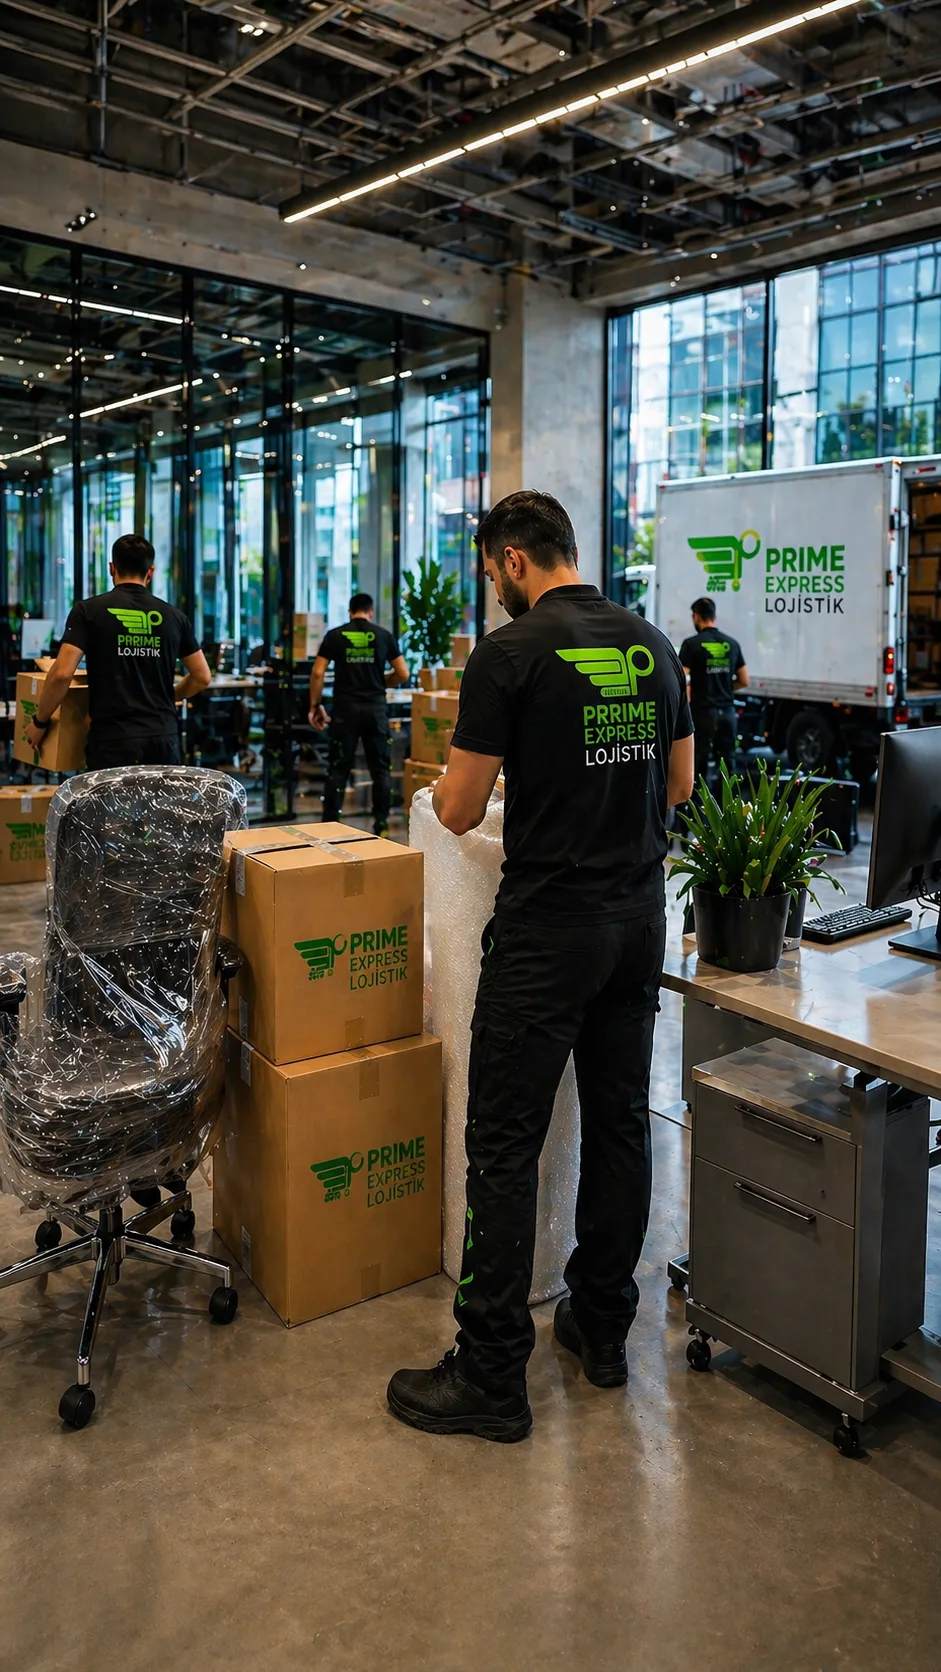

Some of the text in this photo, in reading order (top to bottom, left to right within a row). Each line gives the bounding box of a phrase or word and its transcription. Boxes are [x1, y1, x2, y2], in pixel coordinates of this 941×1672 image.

[766, 545, 845, 573] PRIME
[765, 575, 845, 593] EXPRESS
[765, 595, 844, 614] LOJİSTİK
[117, 647, 161, 658] LOJISTIK
[583, 701, 656, 726] PRRIME
[584, 723, 656, 745] EXPRESS
[585, 741, 656, 766] LOJİSTİK
[350, 925, 408, 955] PRIME
[350, 949, 408, 972] EXPRESS
[367, 1136, 425, 1172] PRIME
[367, 1160, 426, 1189] EXPRESS
